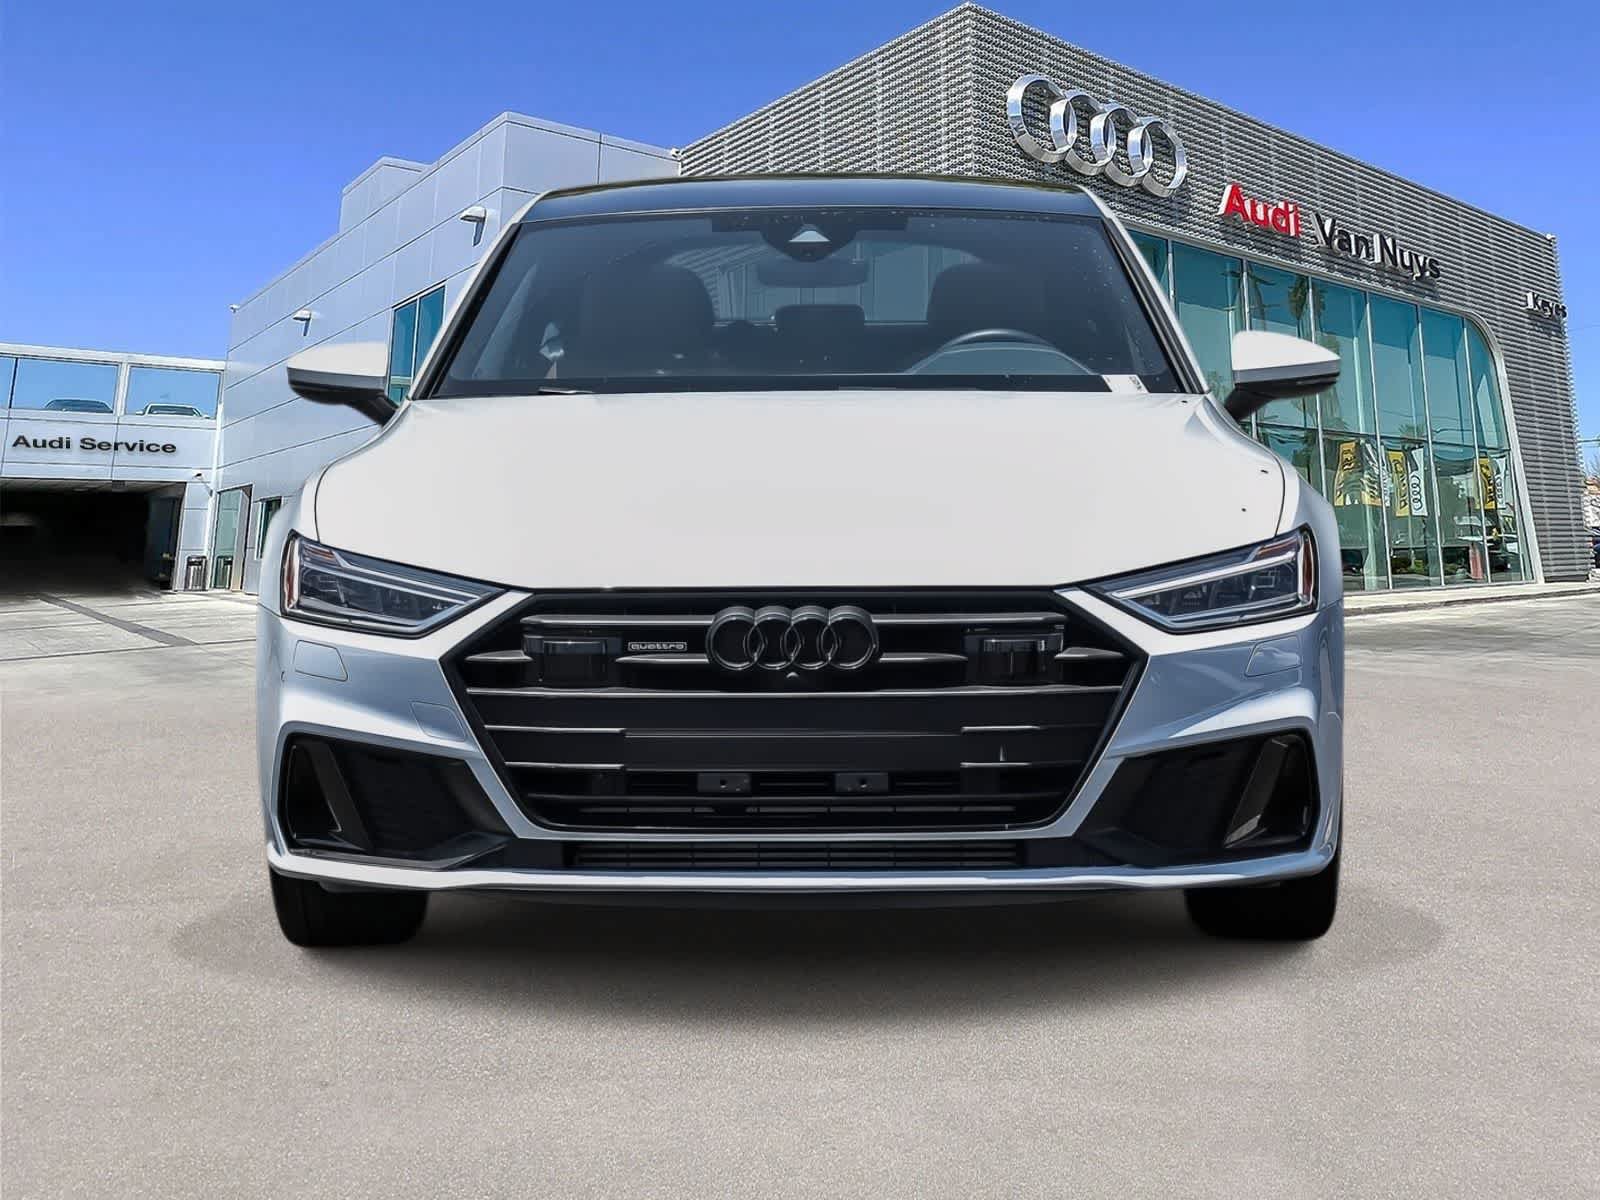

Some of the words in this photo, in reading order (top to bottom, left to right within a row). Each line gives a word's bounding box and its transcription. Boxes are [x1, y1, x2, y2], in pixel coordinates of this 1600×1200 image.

[1218, 183, 1302, 238] Audi
[1311, 212, 1372, 259] Van
[1373, 233, 1441, 280] Nuys
[12, 434, 71, 449] Audi
[80, 437, 177, 454] Service
[630, 642, 685, 650] quattro
